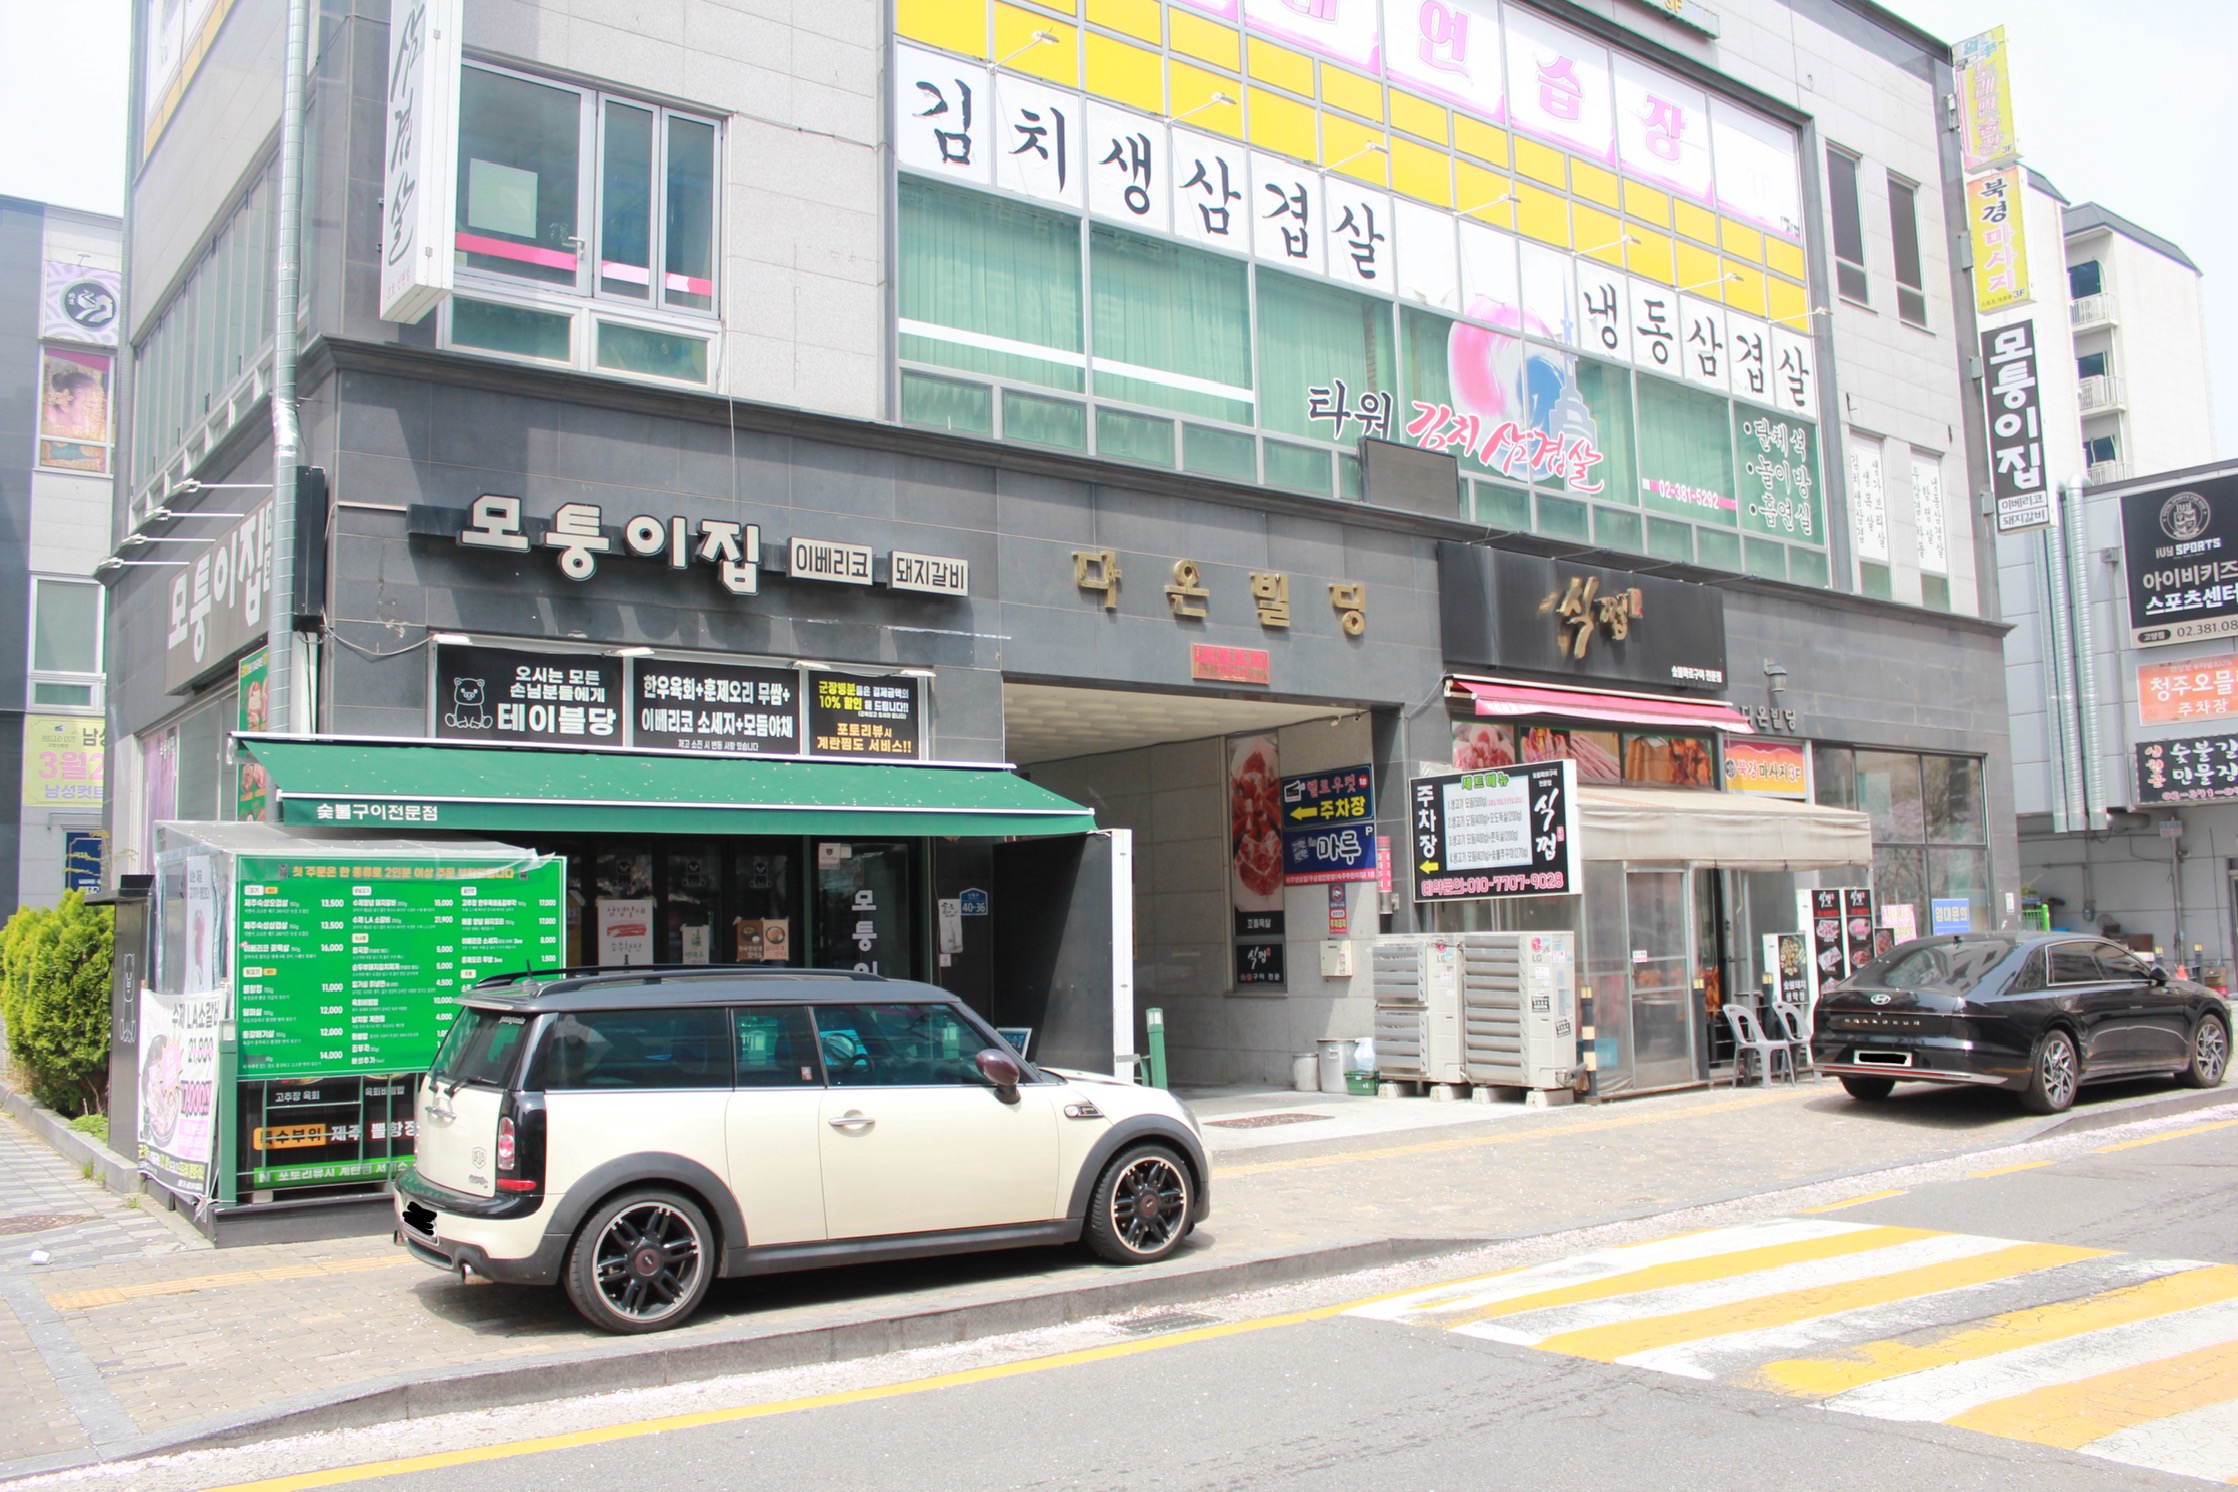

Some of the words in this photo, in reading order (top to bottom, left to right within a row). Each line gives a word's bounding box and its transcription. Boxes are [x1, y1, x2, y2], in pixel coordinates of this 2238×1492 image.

[911, 78, 1384, 279] 김치생삼겹살
[1583, 283, 1810, 407] 냉동삼겹살
[1308, 378, 1392, 440] 타워
[1990, 327, 2040, 490] 모퉁이집
[1754, 417, 1807, 463] 단체석
[1755, 454, 1812, 499] 놀이방
[1658, 479, 1720, 510] 02-381-5292
[2001, 493, 2044, 510] 이베리코
[1759, 492, 1813, 536] 흡연실
[2003, 510, 2046, 526] 돼지갈비
[458, 494, 760, 596] 모퉁이집
[796, 543, 869, 579] 이베리코
[896, 556, 965, 590] 돼지갈비
[2175, 538, 2222, 556] SPORTS
[169, 505, 265, 663] 모퉁이집
[1072, 551, 1367, 636] 다온빌딩
[515, 666, 564, 684] 오시는
[568, 669, 600, 686] 모든
[2151, 669, 2238, 702] 청주오믈
[509, 684, 605, 703] 손님분들에게
[643, 675, 754, 704] 한우육회+훈제오리
[758, 684, 791, 706] 무쌈+
[819, 696, 841, 710] 10%
[844, 698, 863, 710] 할인
[874, 701, 909, 713] 드립니다!!
[2178, 698, 2229, 717] 주차장
[497, 703, 617, 736] 테이블당
[642, 709, 694, 733] 이베리코
[697, 709, 794, 738] 소세지+모듬야채
[817, 736, 866, 751] 계란찜도
[868, 738, 912, 754] 서비스!!
[316, 802, 438, 821] 숯불구이전문점
[1320, 796, 1366, 820] 주차장
[1365, 826, 1374, 836] P
[1417, 785, 1438, 859] 주차장
[1317, 830, 1362, 865] 마루
[320, 899, 344, 908] 13,500
[962, 902, 986, 913] 40-36
[1935, 906, 1968, 922] 임대문의
[320, 921, 344, 930] 13,500
[320, 944, 344, 952] 16,000
[1532, 955, 1543, 963] LG
[321, 983, 343, 992] 11,000
[320, 1006, 343, 1015] 12,000
[1844, 1018, 1921, 1026] GRANDEUR
[320, 1028, 343, 1036] 12,000
[319, 1051, 343, 1059] 14,000
[275, 1092, 301, 1102] 고추장
[303, 1090, 320, 1100] 육회
[331, 1124, 361, 1142] 제주
